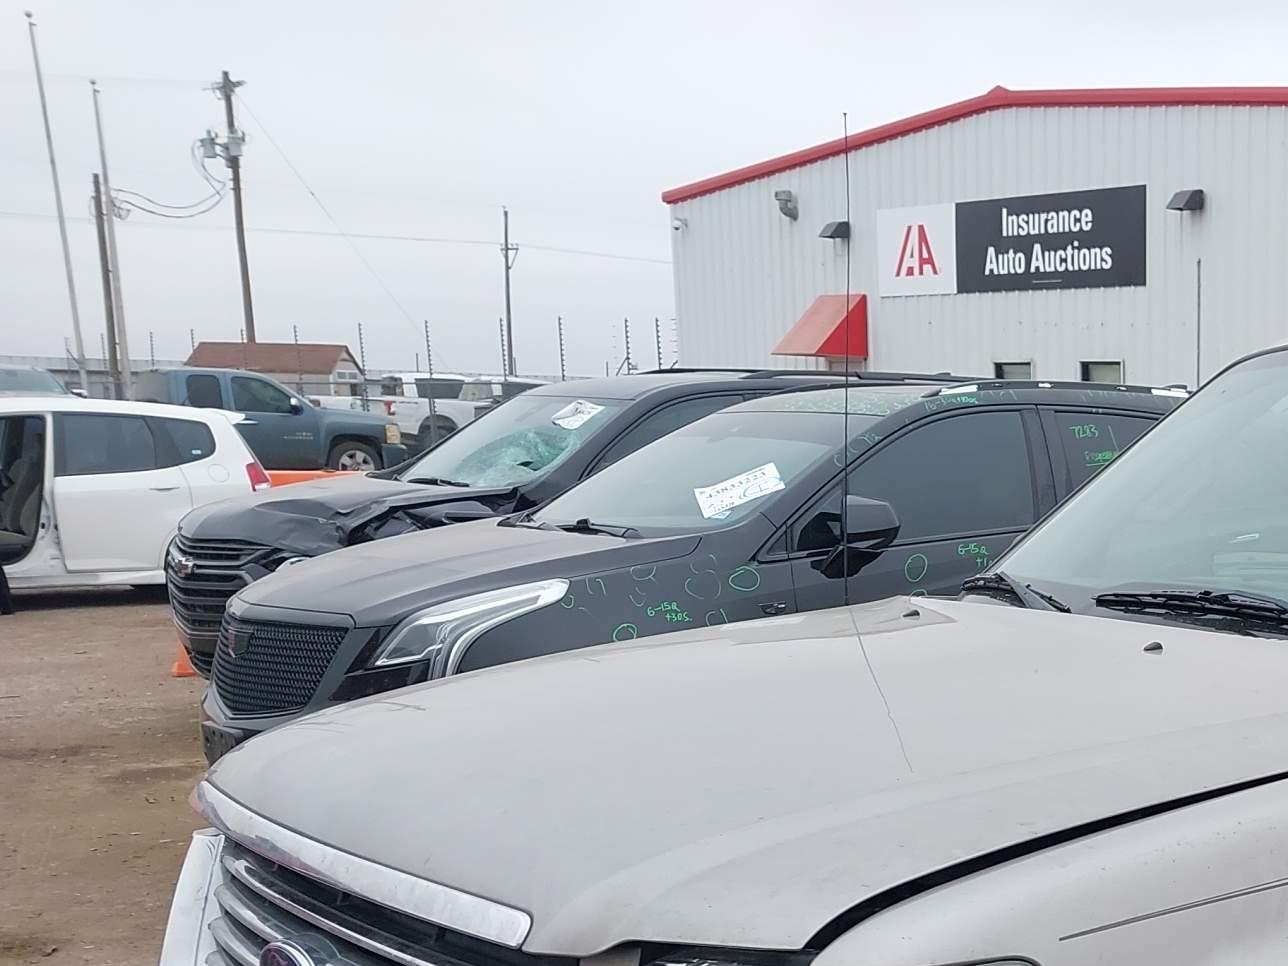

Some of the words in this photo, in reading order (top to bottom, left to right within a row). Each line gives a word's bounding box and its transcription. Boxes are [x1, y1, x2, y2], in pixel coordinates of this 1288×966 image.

[1001, 207, 1094, 238] Insurance
[984, 246, 1027, 276] Auto
[1030, 240, 1113, 274] Auctions
